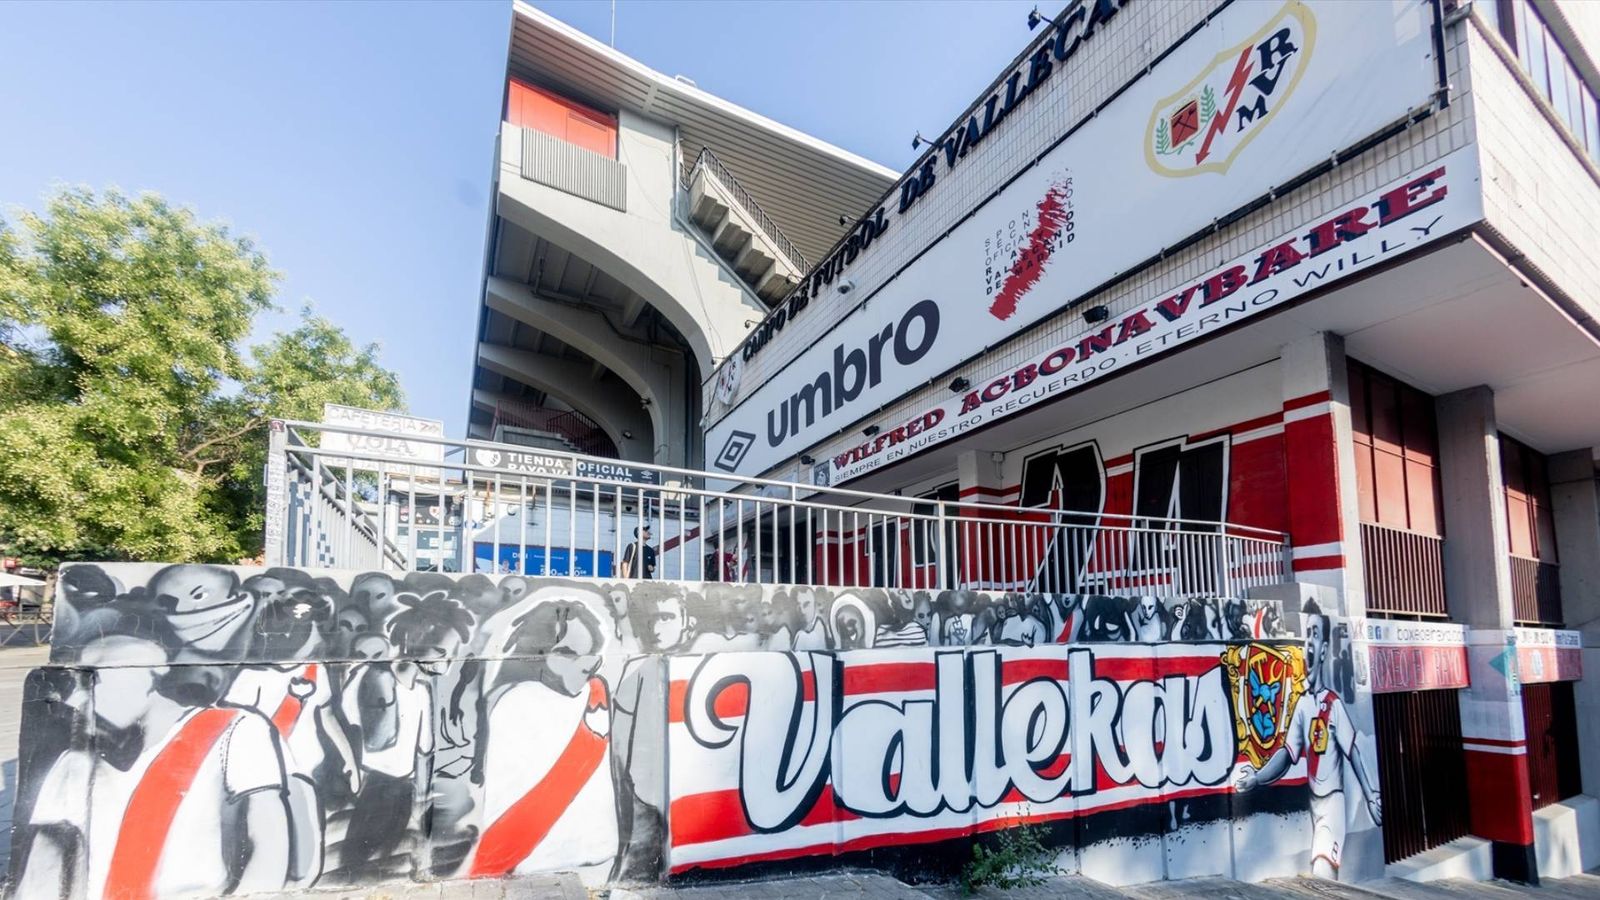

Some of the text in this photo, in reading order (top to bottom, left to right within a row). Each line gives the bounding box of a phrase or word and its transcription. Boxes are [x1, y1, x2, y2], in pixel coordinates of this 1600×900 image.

[743, 0, 1131, 362] CAMPO DE FUTBOL DE VALLECA
[767, 299, 941, 448] umbro
[833, 165, 1448, 471] WILFRED AGBONAVBARE
[834, 215, 1444, 482] SIEMPRE EN NUESTRO RECUERDO ETERNO WILLY
[507, 452, 632, 478] TIENDA OFICIAL
[684, 646, 1236, 833] Vallekas
